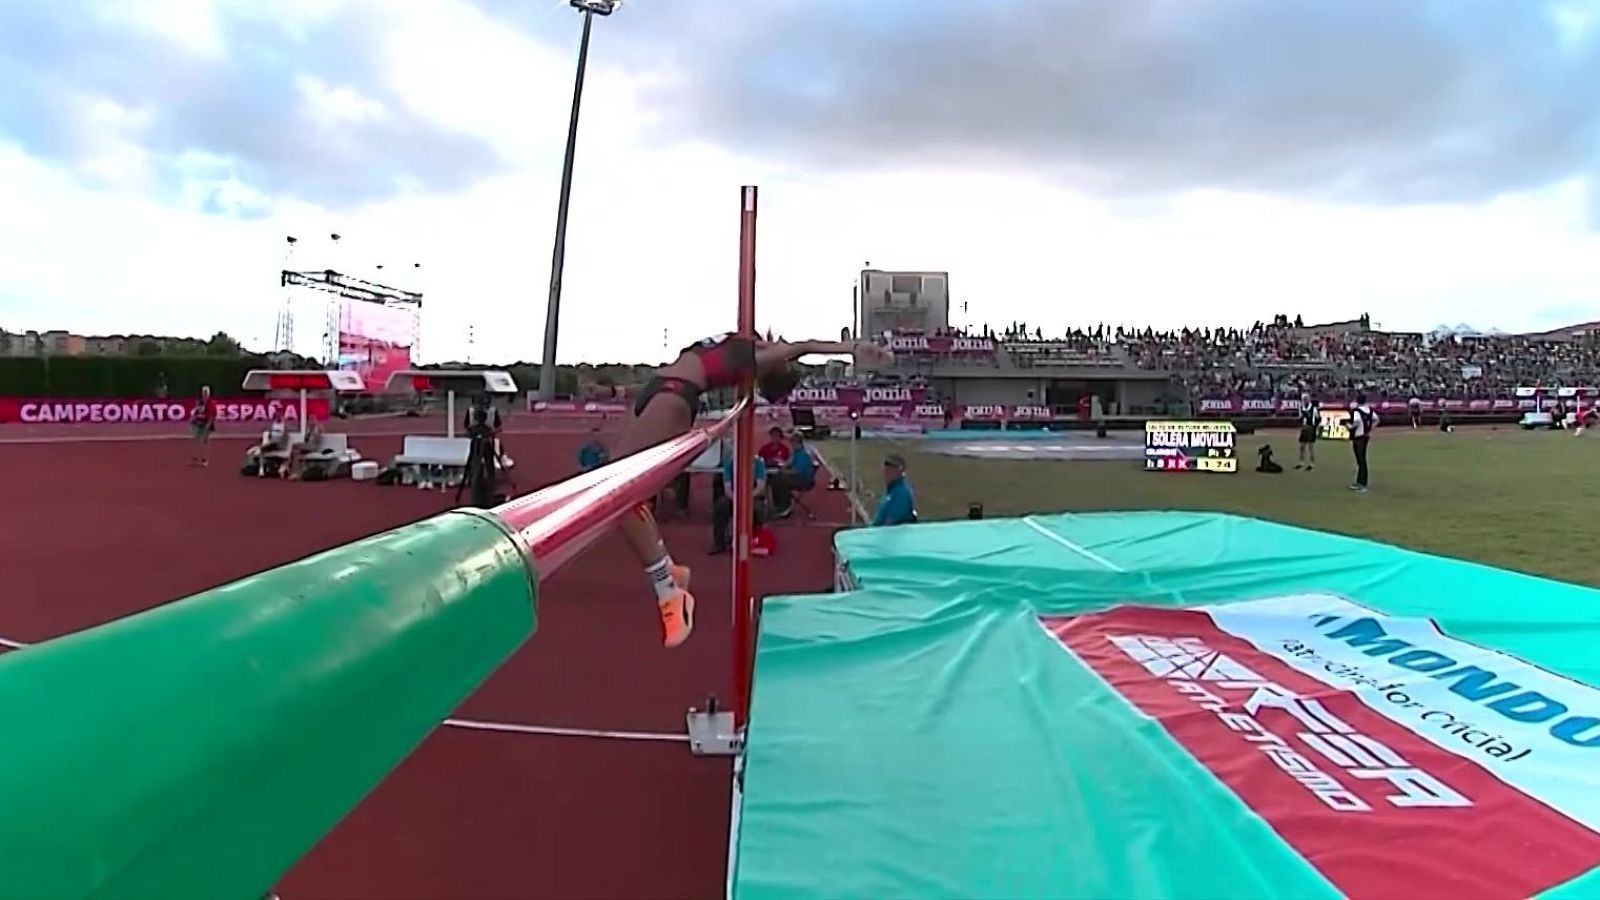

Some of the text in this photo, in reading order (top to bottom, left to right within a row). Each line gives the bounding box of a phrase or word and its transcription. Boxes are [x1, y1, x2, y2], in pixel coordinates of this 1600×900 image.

[20, 403, 186, 422] CAMPEONATO
[1152, 432, 1189, 447] SOLERA
[1190, 431, 1234, 447] MOVILLA
[1324, 617, 1600, 747] MONDO
[1167, 680, 1374, 812] ATLETISMO
